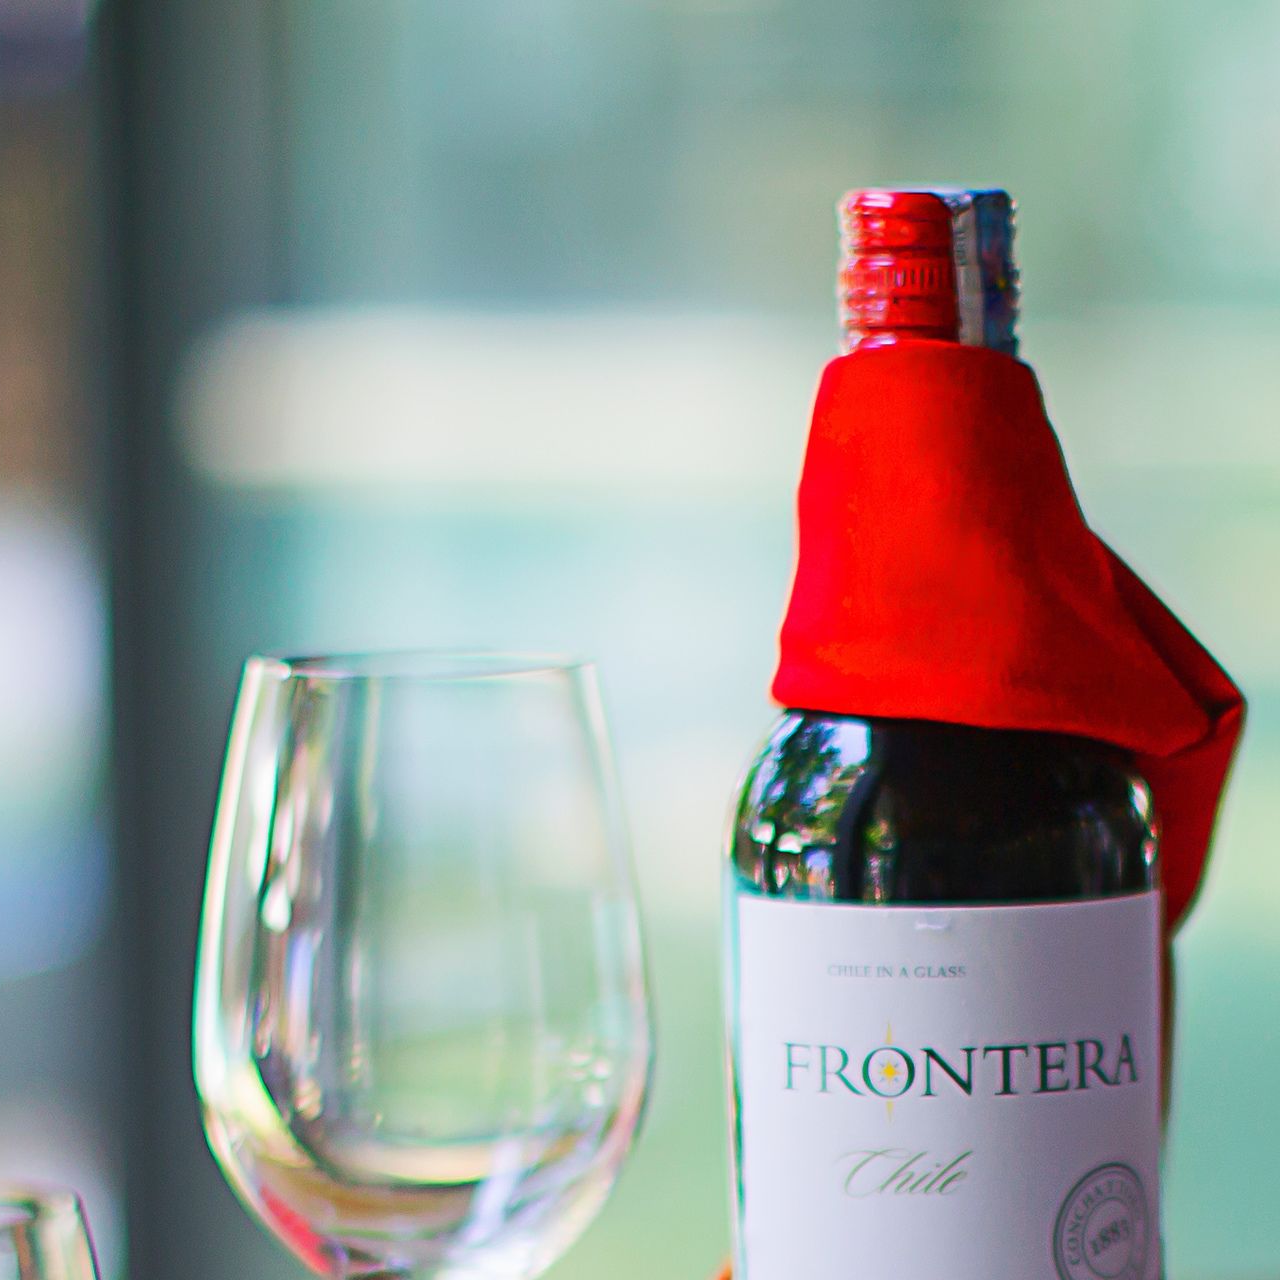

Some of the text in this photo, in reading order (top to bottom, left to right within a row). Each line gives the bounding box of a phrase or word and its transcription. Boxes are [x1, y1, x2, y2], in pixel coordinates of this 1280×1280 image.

[826, 964, 967, 979] CHILE IN A GLASS
[782, 1032, 1139, 1098] FRONTERA
[835, 1146, 975, 1197] Chile
